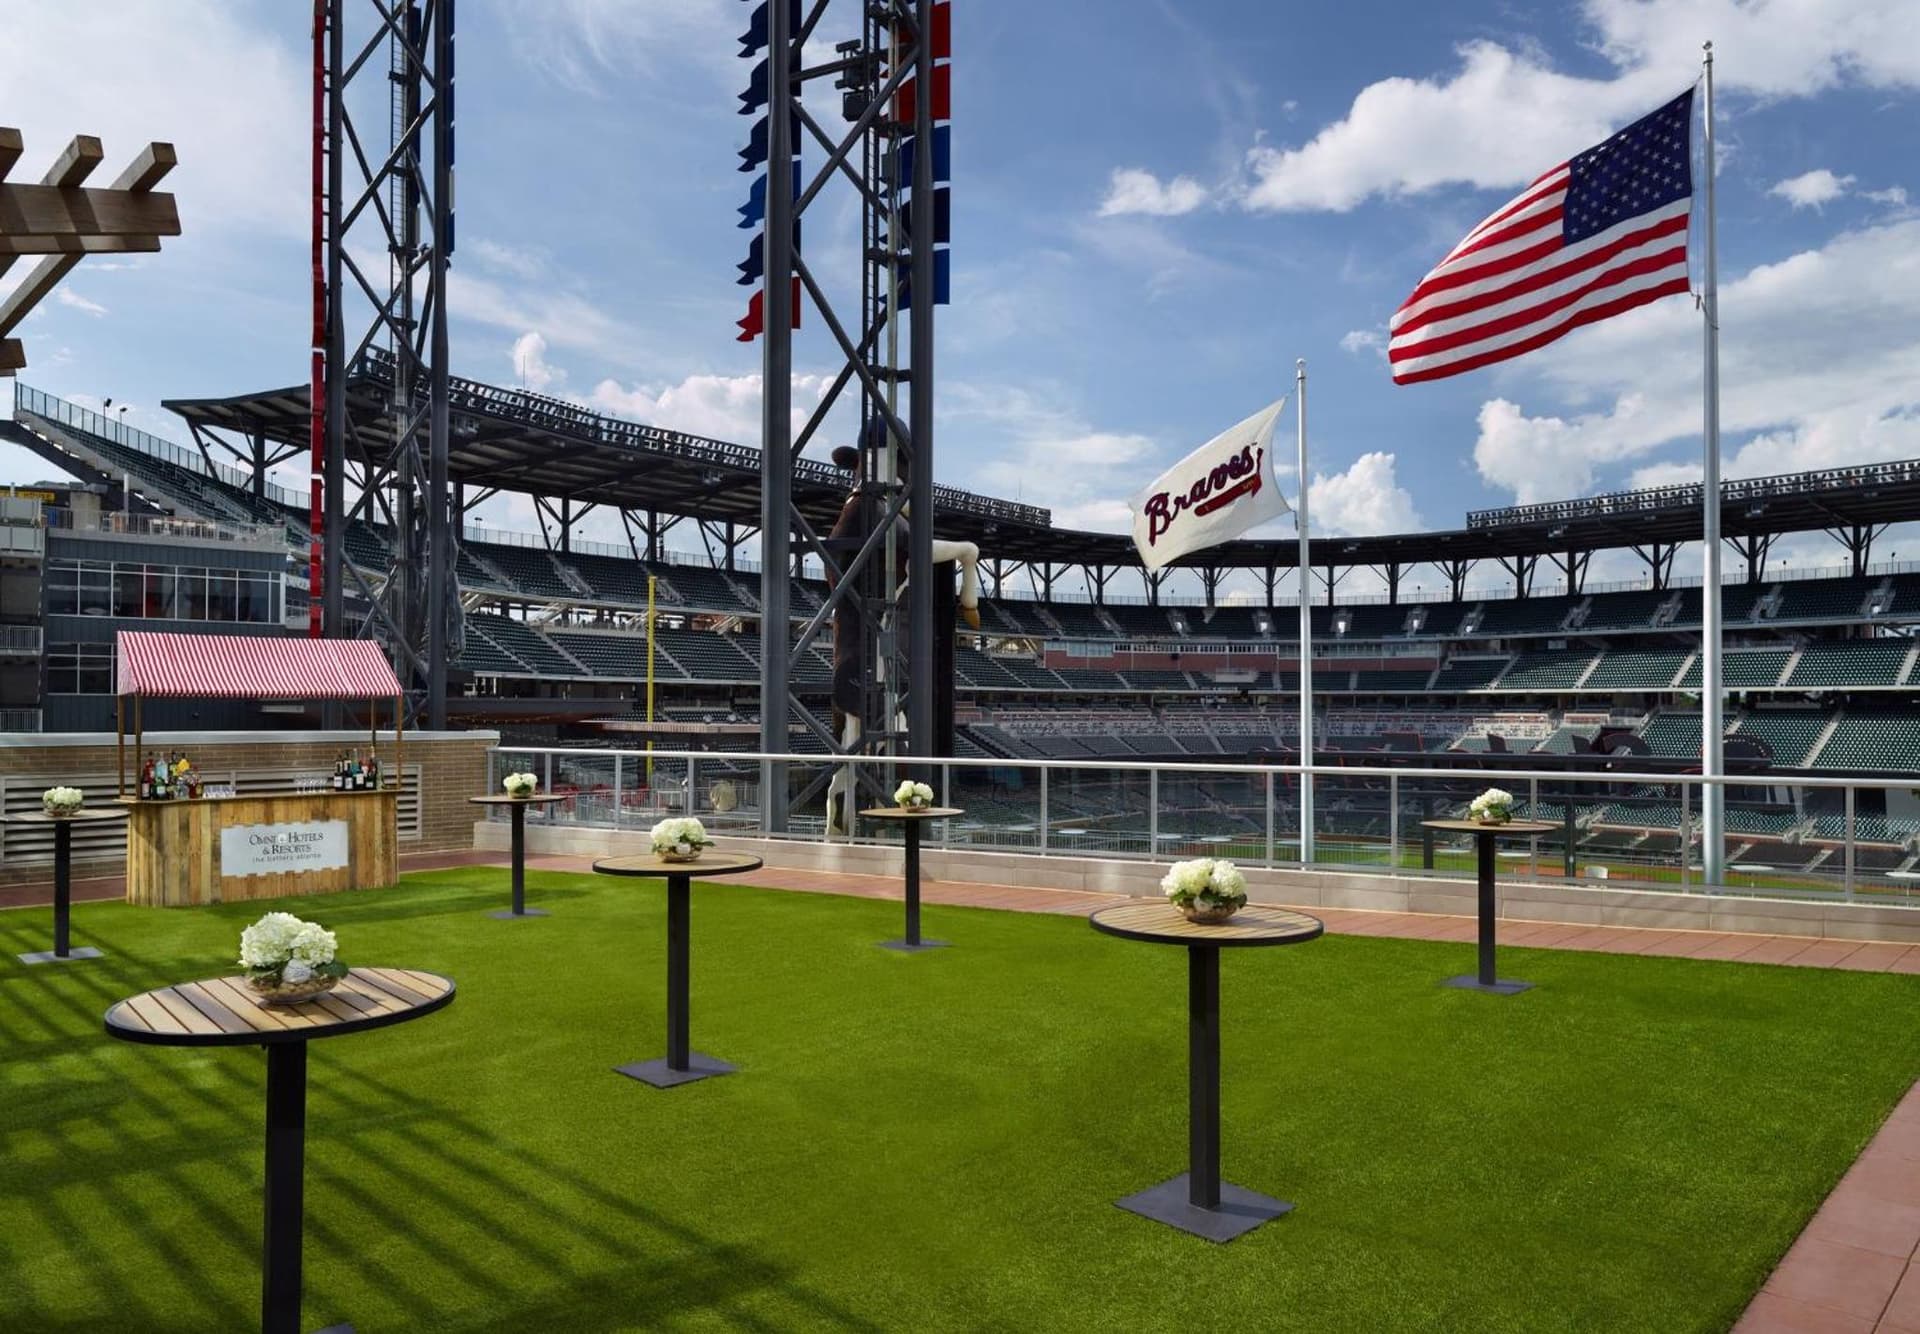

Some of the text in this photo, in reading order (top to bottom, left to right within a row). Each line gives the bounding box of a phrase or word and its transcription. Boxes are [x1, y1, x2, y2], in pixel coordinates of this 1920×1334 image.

[1144, 445, 1255, 547] Braves
[249, 831, 324, 846] OMNI HOTELS
[262, 844, 311, 855] & RESORTS
